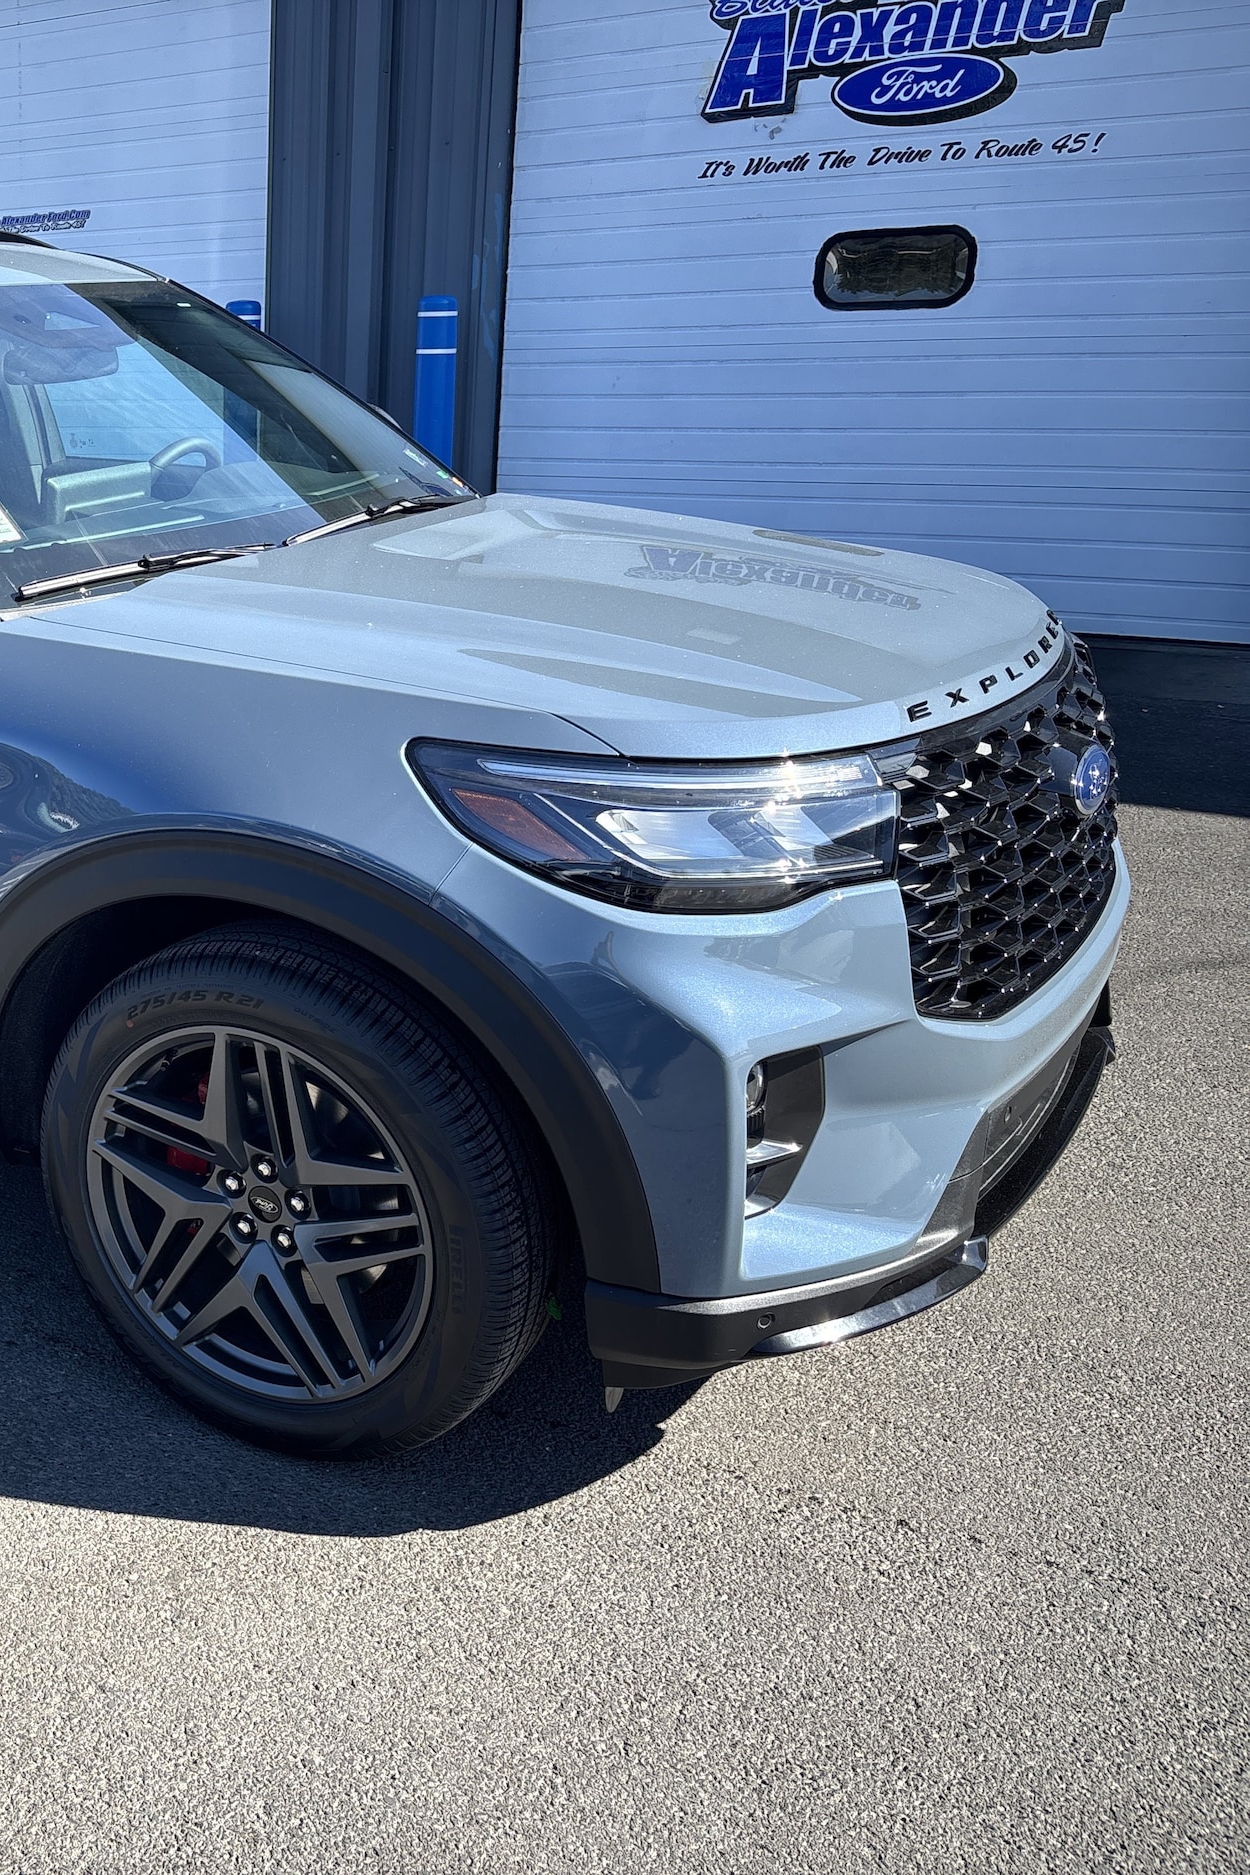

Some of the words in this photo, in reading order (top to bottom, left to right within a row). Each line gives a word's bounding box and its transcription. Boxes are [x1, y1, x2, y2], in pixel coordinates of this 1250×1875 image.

[704, 0, 1099, 113] Alexander
[869, 63, 963, 106] Ford
[697, 159, 736, 180] It's
[742, 152, 811, 177] Worth
[818, 149, 857, 171] The
[866, 146, 933, 167] Drive
[940, 140, 967, 162] To
[973, 137, 1044, 160] Route
[126, 990, 209, 1021] 275/45
